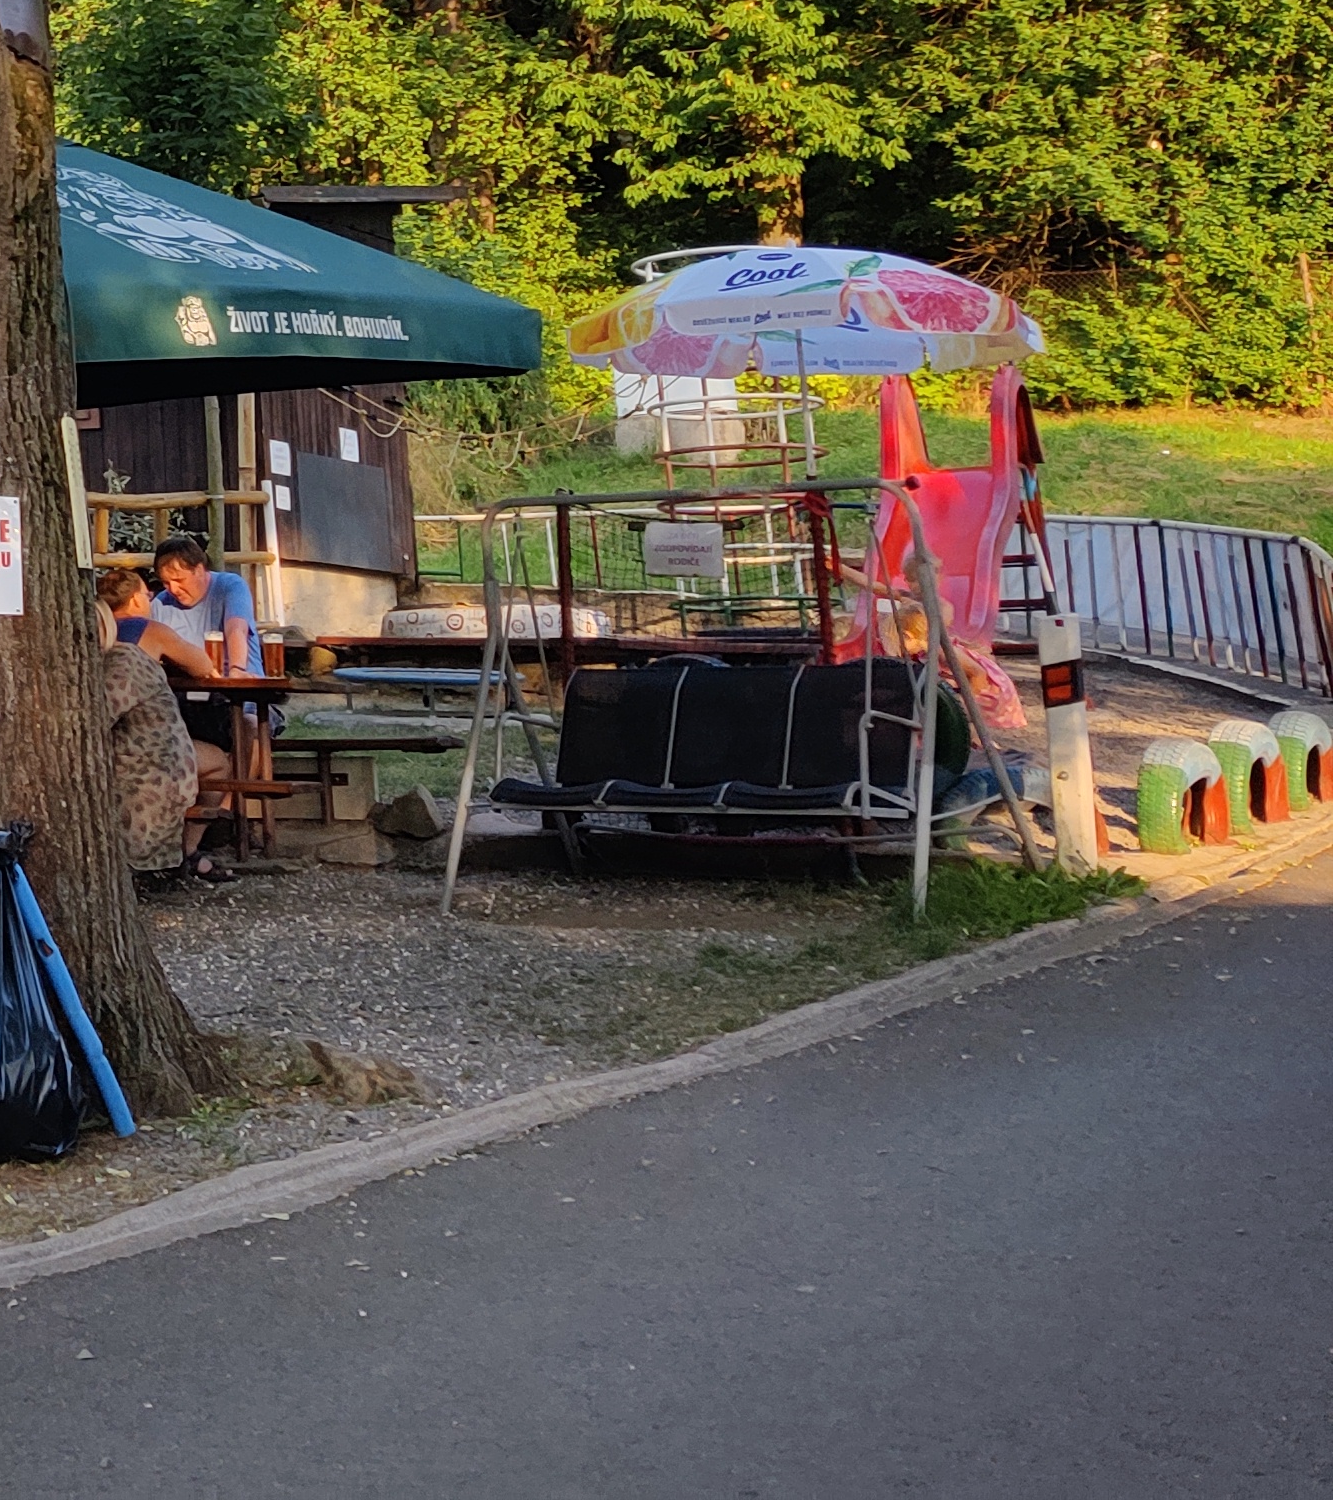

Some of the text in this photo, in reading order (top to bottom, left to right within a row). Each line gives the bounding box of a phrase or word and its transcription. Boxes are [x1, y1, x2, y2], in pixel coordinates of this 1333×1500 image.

[720, 263, 809, 290] Cool
[226, 306, 409, 341] ŽIVOT JE HOŘKÝ. BOHUDÍK.
